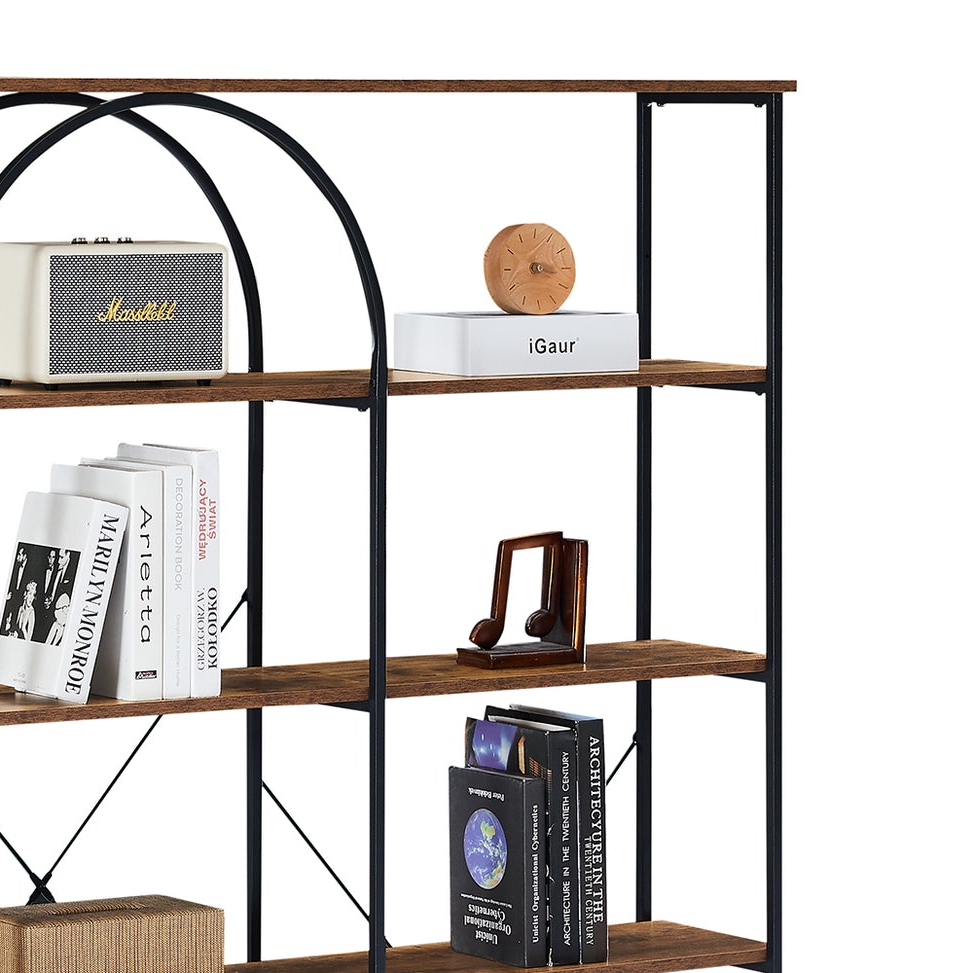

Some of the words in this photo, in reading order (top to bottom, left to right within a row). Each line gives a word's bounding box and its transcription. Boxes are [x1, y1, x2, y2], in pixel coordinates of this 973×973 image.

[529, 338, 576, 354] iGaur
[174, 478, 184, 554] DECORATION
[206, 498, 217, 540] ŚWIAT
[83, 513, 120, 608] MARILYN
[140, 506, 153, 644] Arletta
[174, 557, 183, 590] BOOK
[208, 587, 218, 669] KOŁODKO
[64, 607, 101, 695] MONROE
[562, 752, 570, 790] CENTURY
[562, 798, 570, 843] TWENTIETH
[590, 736, 602, 864] ARCHITECYURE
[532, 804, 540, 850] Cybernetics
[532, 853, 540, 912] Organizational
[563, 869, 570, 877] IN
[584, 836, 593, 896] TWENTIETH
[592, 867, 602, 887] IN
[464, 915, 512, 936] Organizational
[468, 904, 506, 922] Cybernetics
[584, 899, 594, 946] CENTURY
[592, 888, 604, 924] THE
[475, 930, 498, 945] Unicist
[532, 915, 540, 943] Unicist
